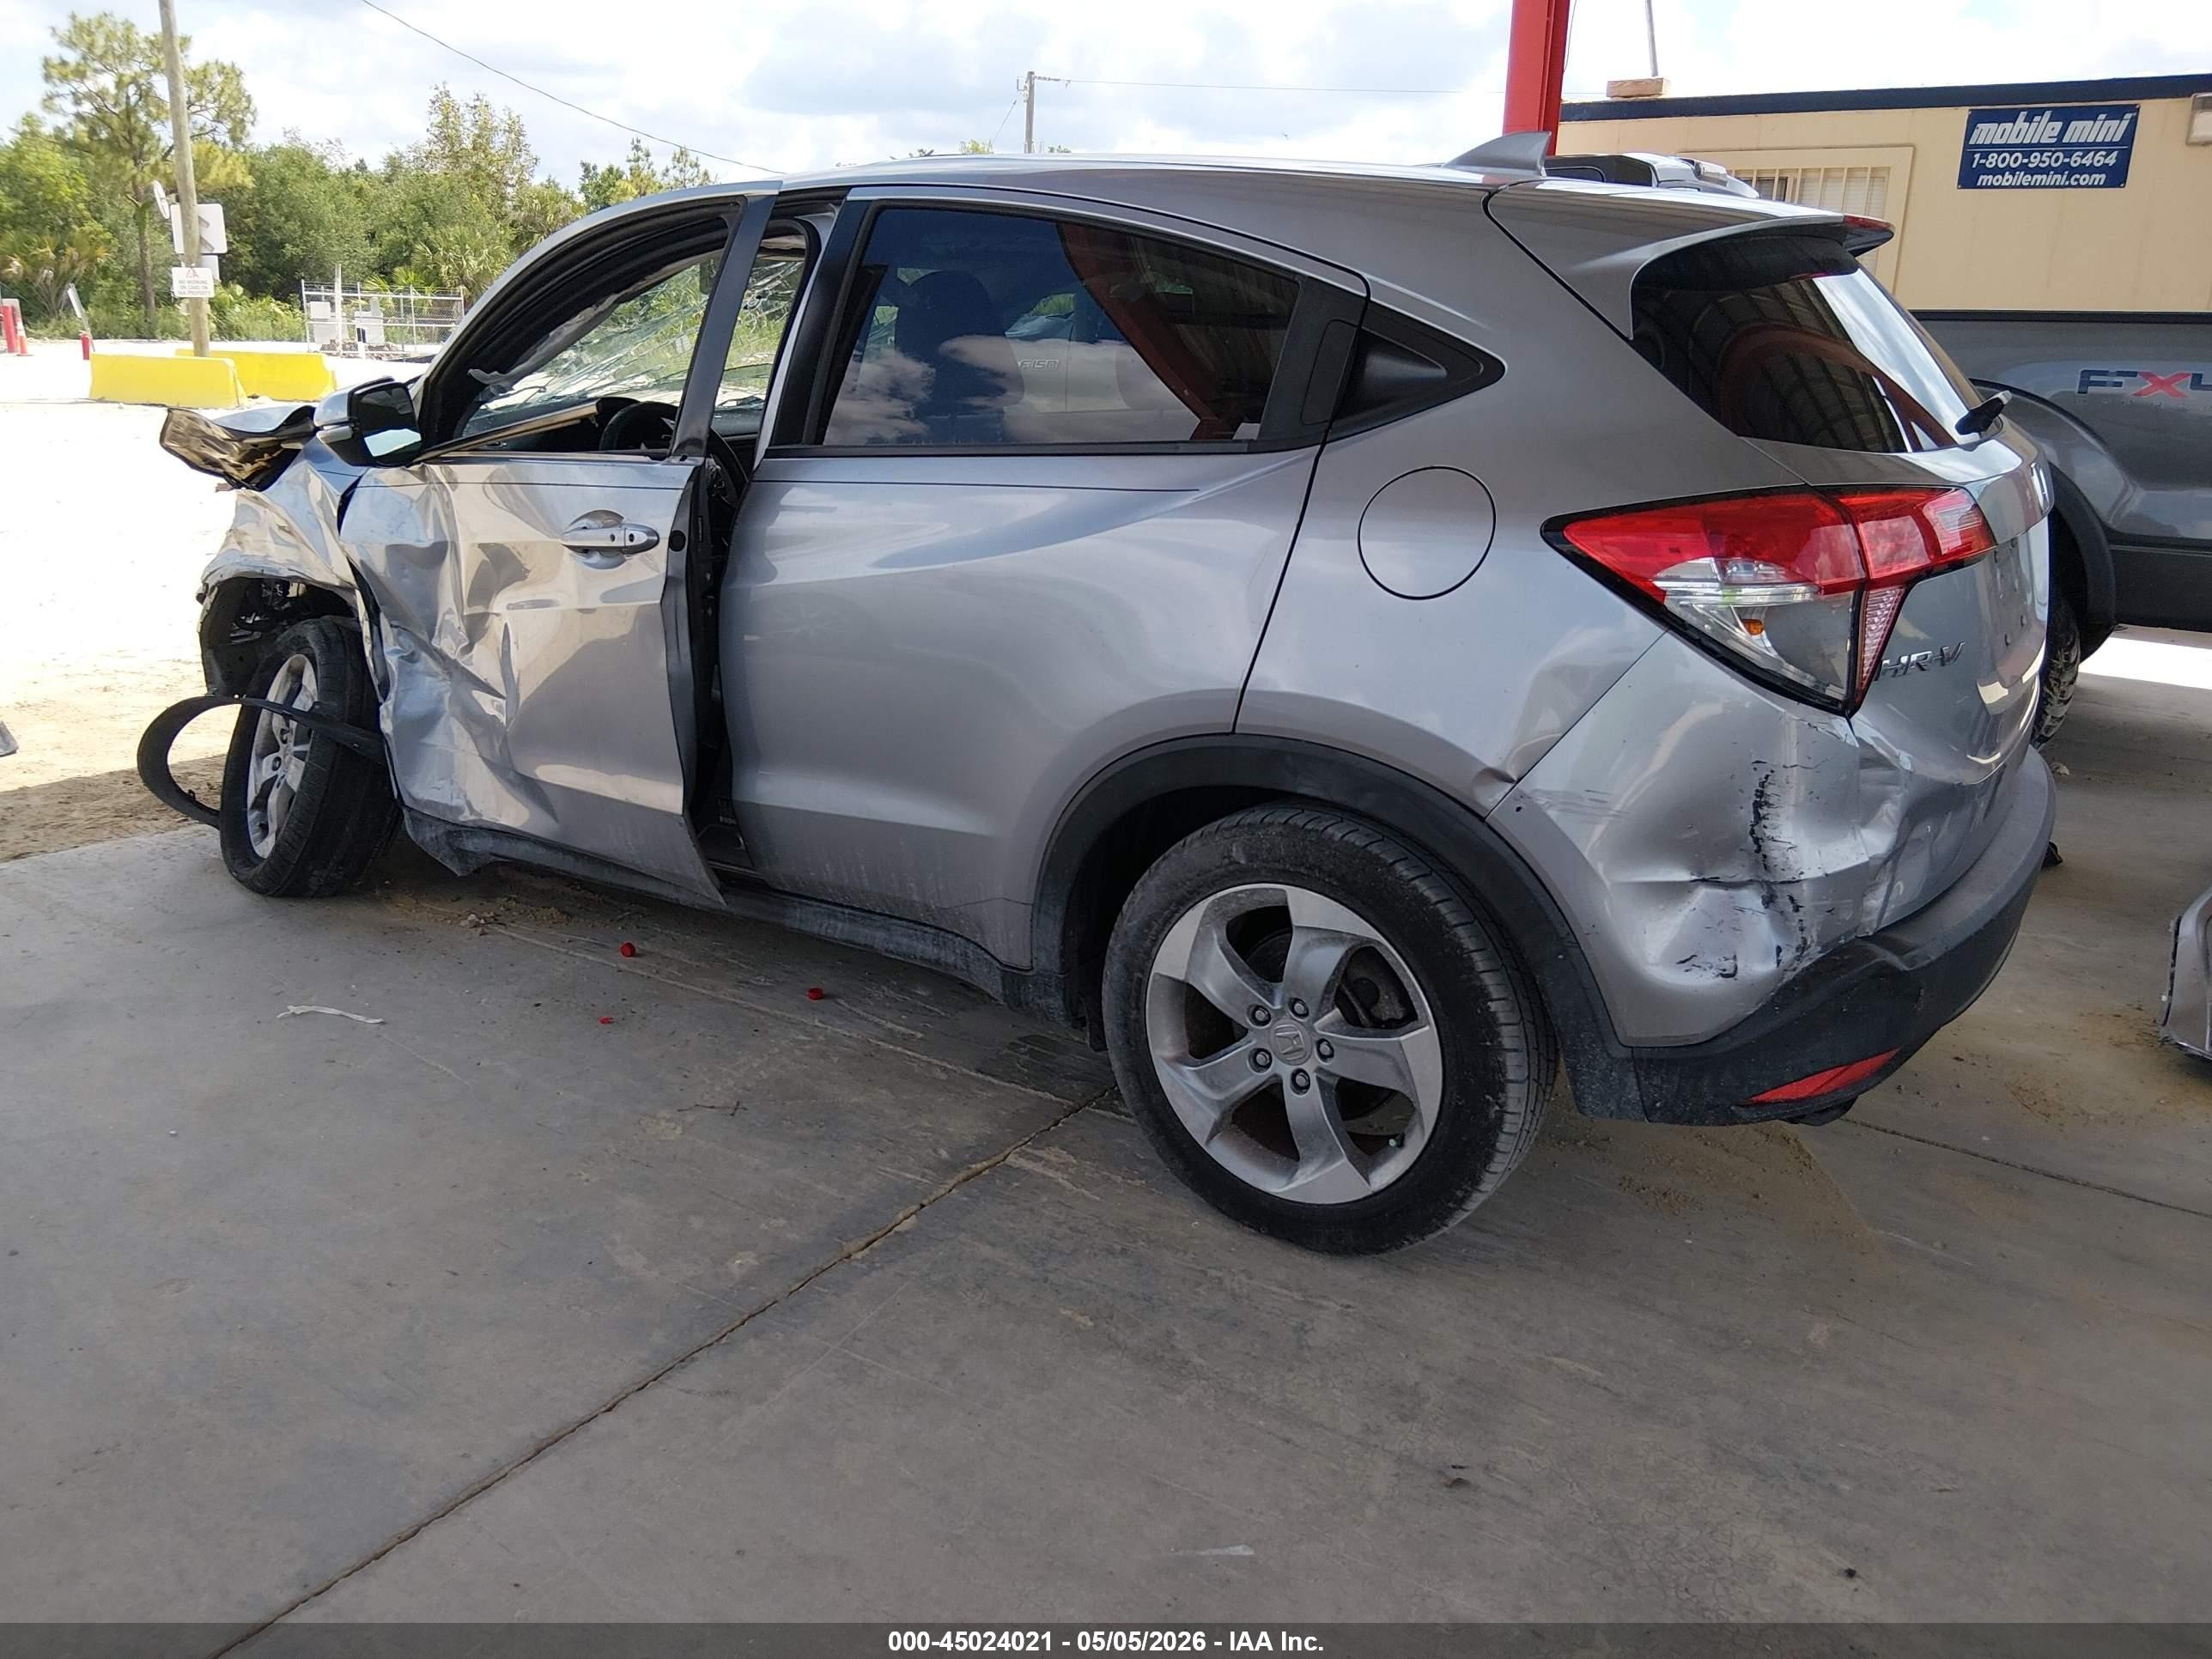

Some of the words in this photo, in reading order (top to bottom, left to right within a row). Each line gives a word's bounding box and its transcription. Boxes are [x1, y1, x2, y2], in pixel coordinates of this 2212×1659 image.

[1968, 110, 2063, 145] mobile
[2062, 113, 2132, 143] mini
[1972, 150, 2118, 168] 1-800-950-6464
[1976, 171, 2106, 186] mobilemini.com
[1874, 641, 1965, 681] HR-V
